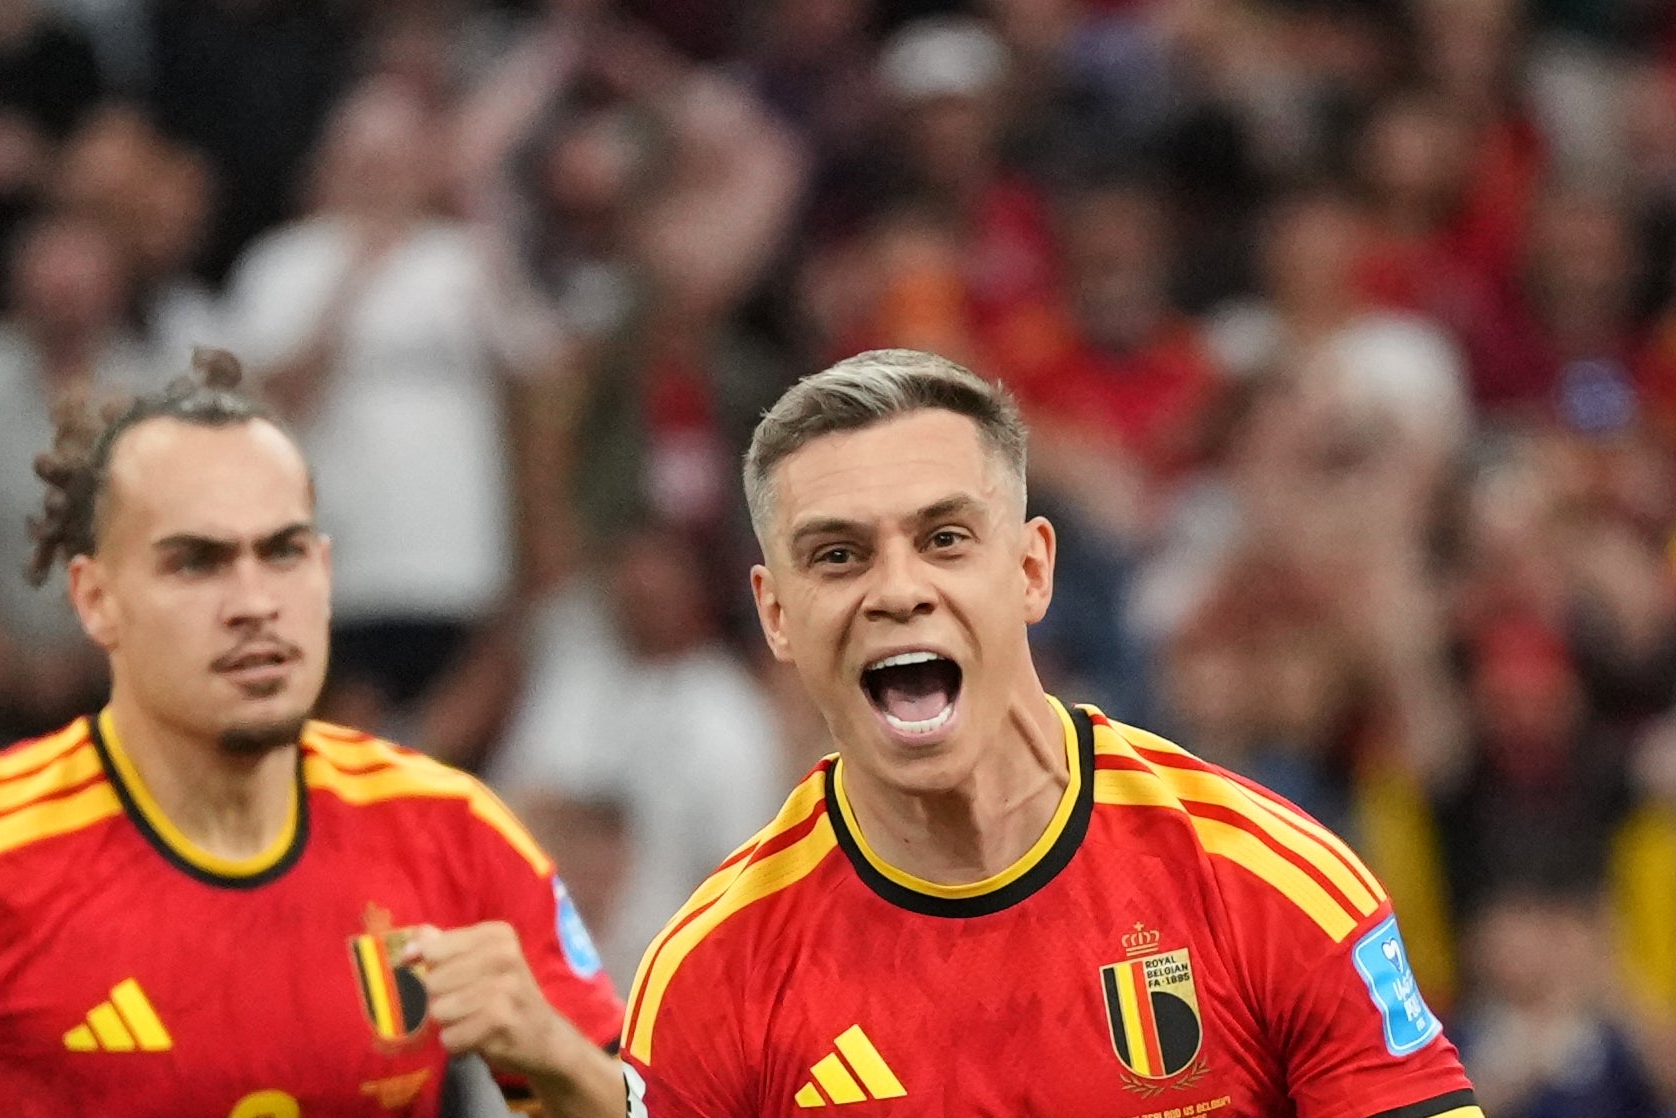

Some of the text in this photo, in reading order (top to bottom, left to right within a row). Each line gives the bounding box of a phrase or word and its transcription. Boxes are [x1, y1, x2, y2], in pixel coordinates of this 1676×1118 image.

[1145, 956, 1176, 969] ROYAL
[1147, 963, 1189, 979] BELGIAN
[1196, 1096, 1231, 1113] BELGIUM
